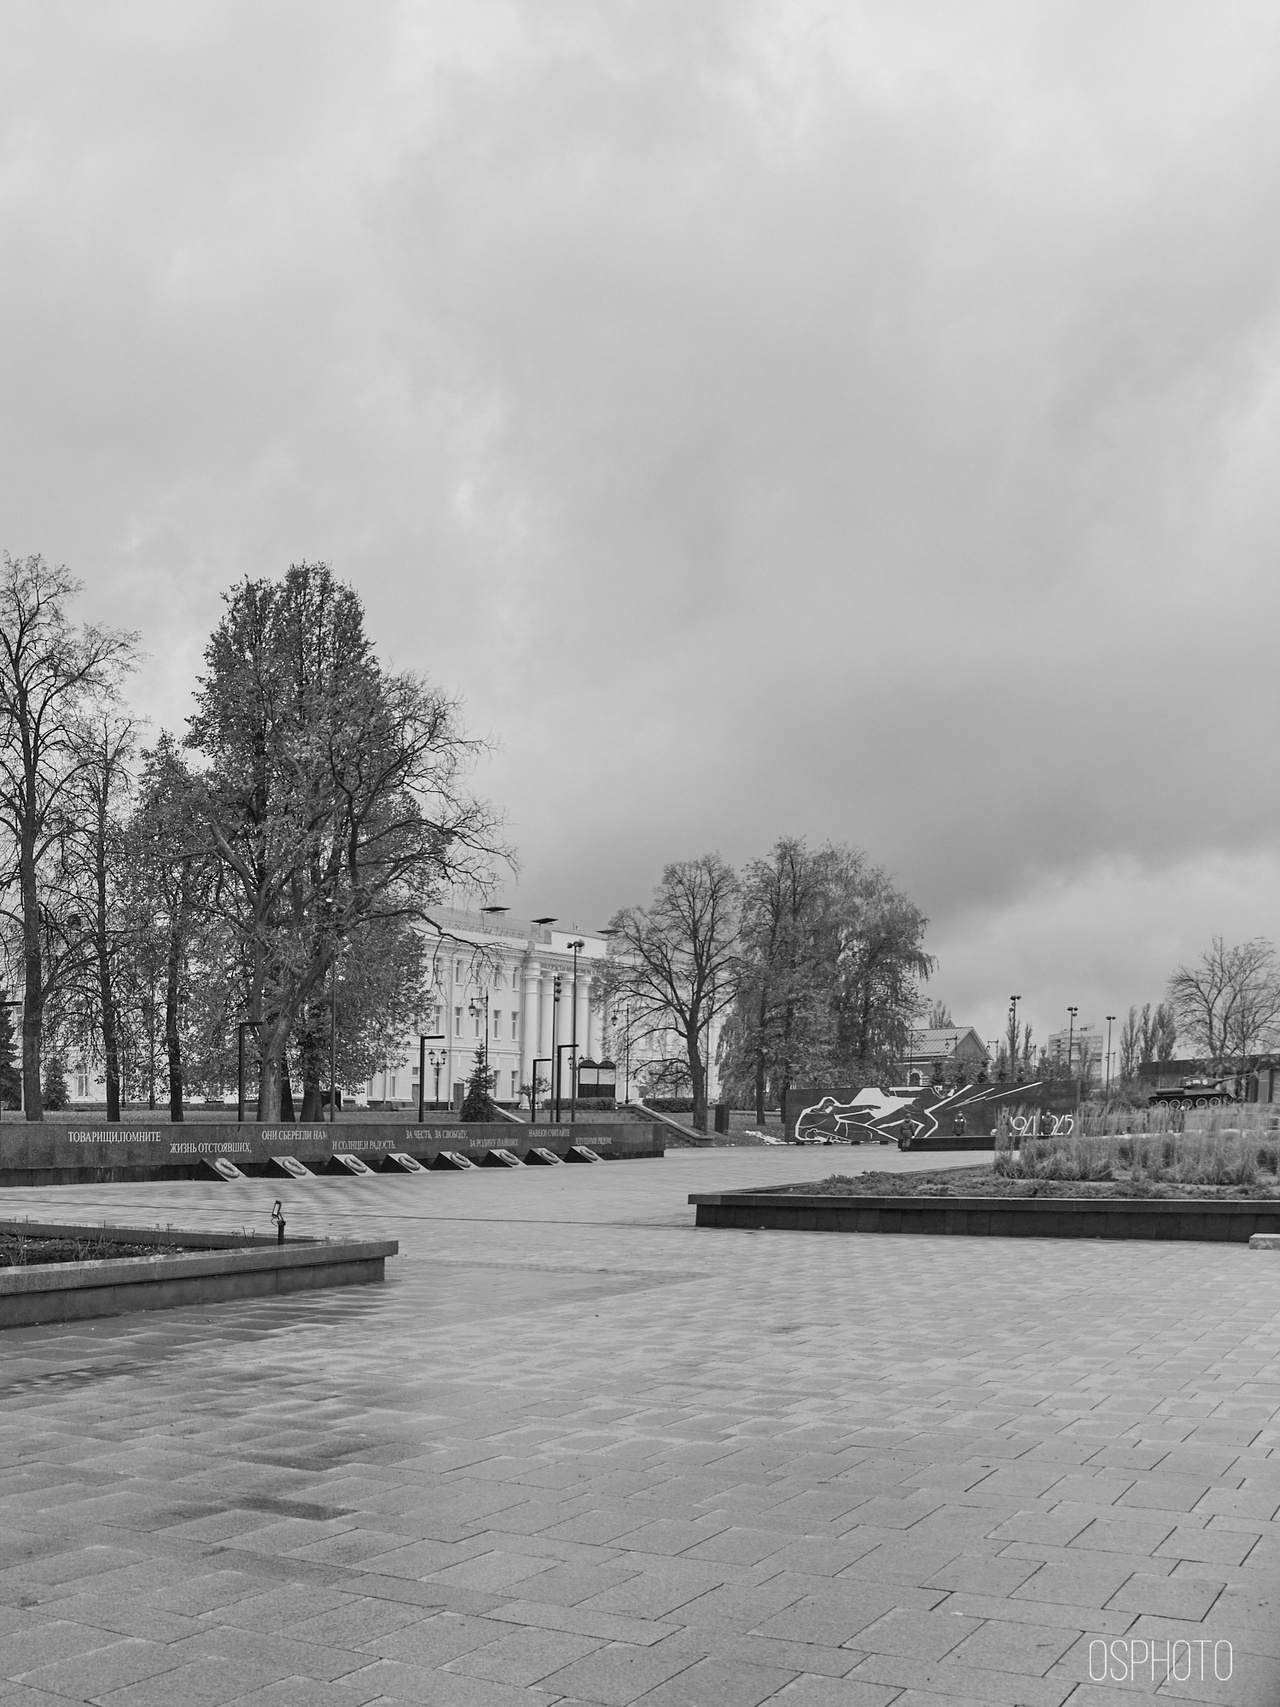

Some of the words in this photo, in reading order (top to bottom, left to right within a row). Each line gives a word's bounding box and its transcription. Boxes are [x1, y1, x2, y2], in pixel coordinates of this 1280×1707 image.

[261, 1130, 277, 1141] ОНИ
[278, 1130, 312, 1140] СБЕРЕГЛИ
[405, 1129, 413, 1139] ЗА
[435, 1129, 442, 1139] ЗА
[170, 1142, 198, 1153] ЖИЗНЬ
[198, 1142, 252, 1154] ОТСТОЯВШИХ,
